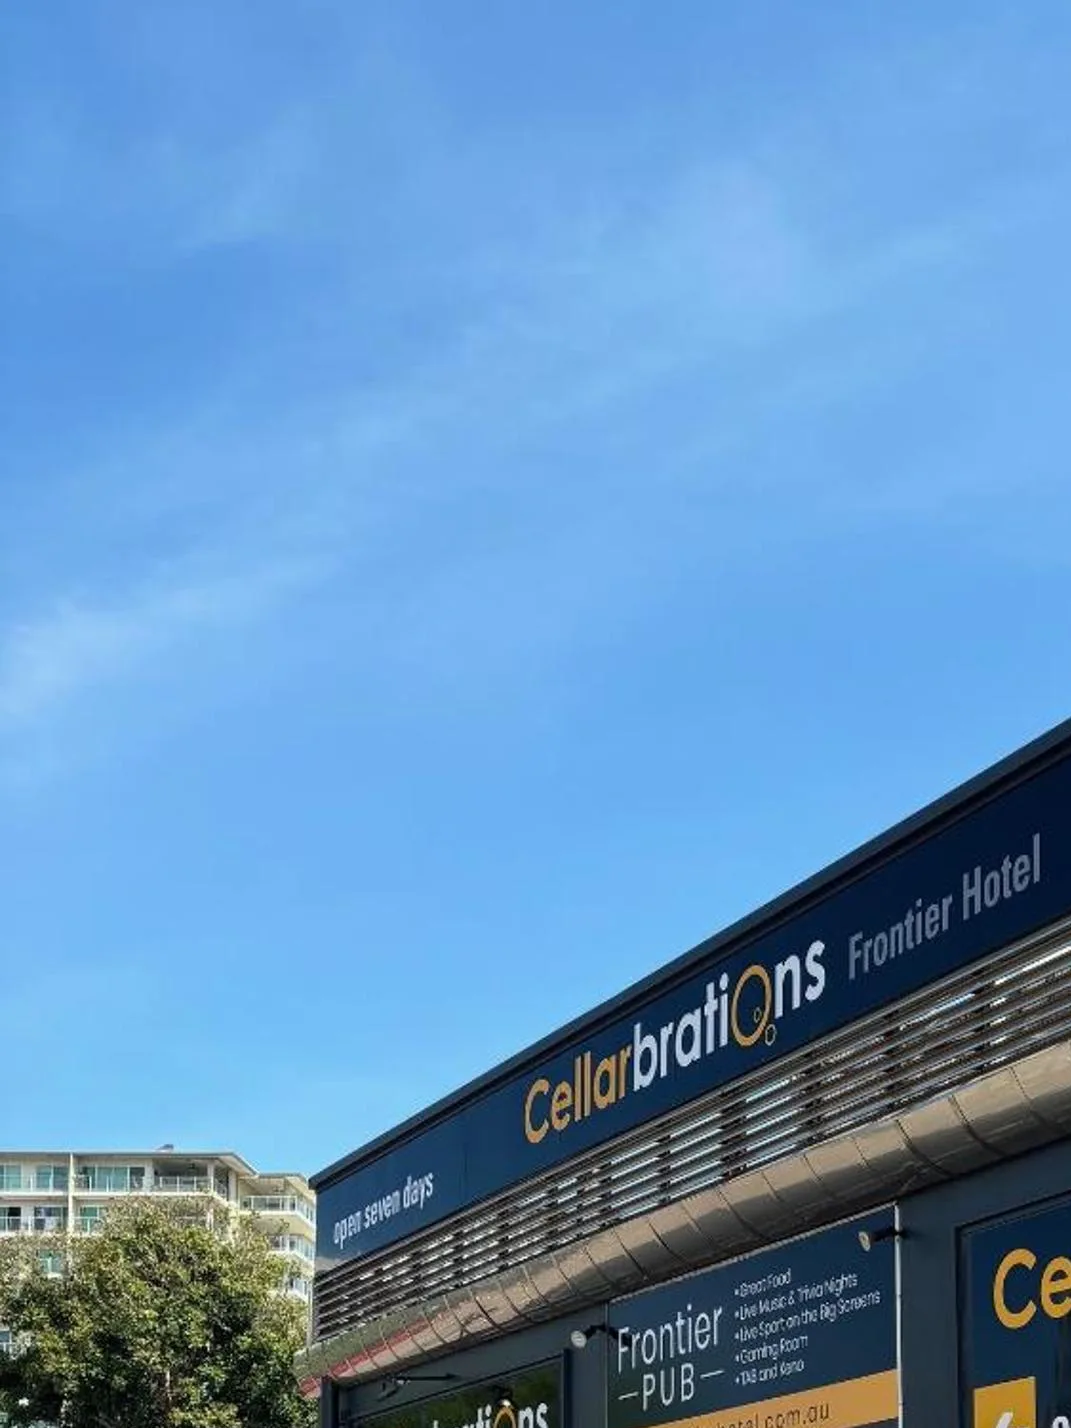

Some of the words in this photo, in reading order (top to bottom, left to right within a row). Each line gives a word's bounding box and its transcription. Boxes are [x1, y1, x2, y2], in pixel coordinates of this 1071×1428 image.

[848, 893, 953, 980] Frontier
[962, 833, 1041, 921] Hotel
[333, 1210, 362, 1249] open
[363, 1190, 401, 1229] seven
[402, 1172, 434, 1209] days
[740, 1279, 767, 1298] Great
[767, 1268, 791, 1289] Food
[740, 1304, 758, 1320] Live
[759, 1296, 787, 1314] Music
[797, 1284, 823, 1302] Trivia
[824, 1273, 858, 1297] Nights
[617, 1303, 723, 1374] Frontier
[740, 1325, 759, 1342] Live
[759, 1318, 785, 1339] Sport
[786, 1315, 801, 1329] on
[801, 1309, 818, 1324] the
[820, 1301, 837, 1322] Big
[837, 1290, 881, 1315] Screens
[740, 1342, 779, 1364] Gaming
[780, 1335, 808, 1354] Room
[740, 1368, 758, 1385] TAB
[759, 1363, 778, 1381] and
[780, 1359, 805, 1376] Keno
[642, 1363, 694, 1411] PUB
